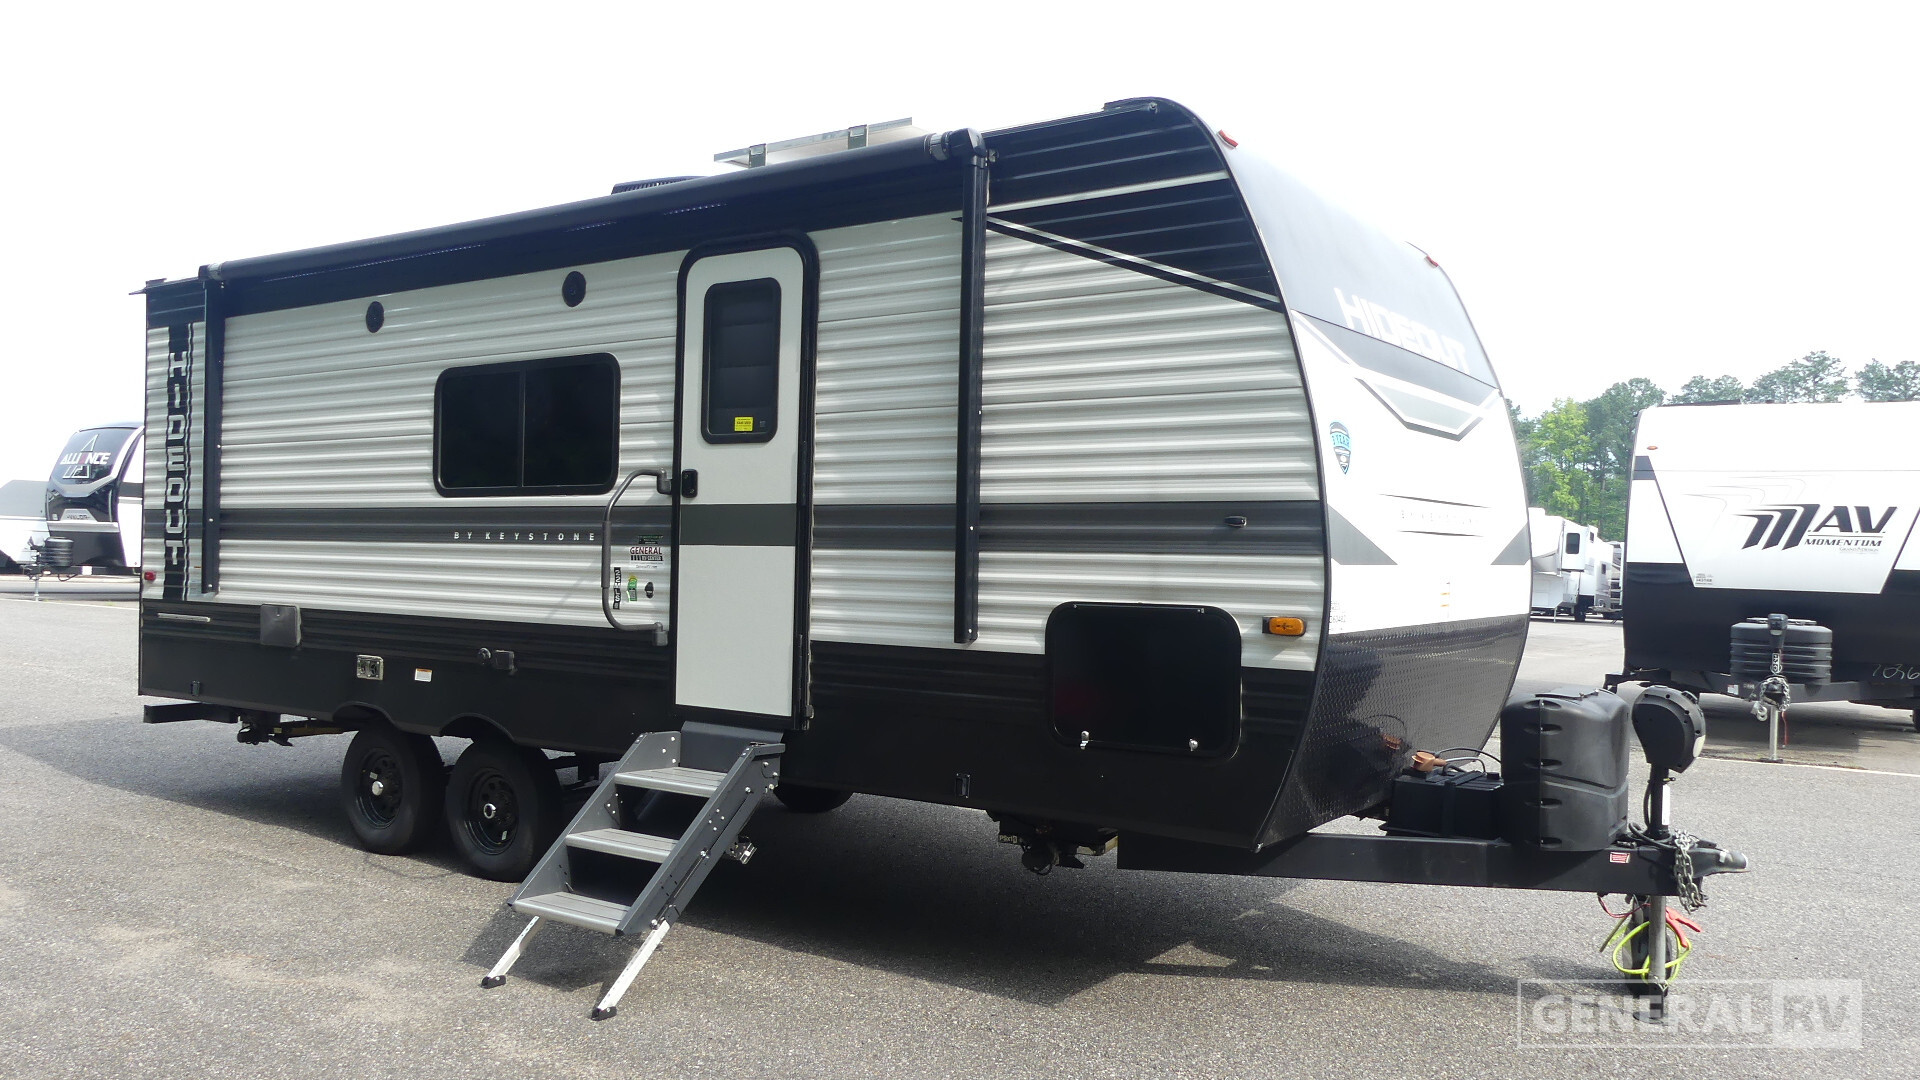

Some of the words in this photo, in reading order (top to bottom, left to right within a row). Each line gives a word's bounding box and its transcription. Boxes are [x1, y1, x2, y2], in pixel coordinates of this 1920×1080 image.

[1333, 287, 1470, 375] HIDEOUT
[166, 351, 188, 565] HIDEOUT
[453, 531, 473, 539] BY
[485, 532, 595, 541] KEYSTONE
[1804, 538, 1883, 547] MOMENTUM
[630, 546, 663, 555] GENERAL
